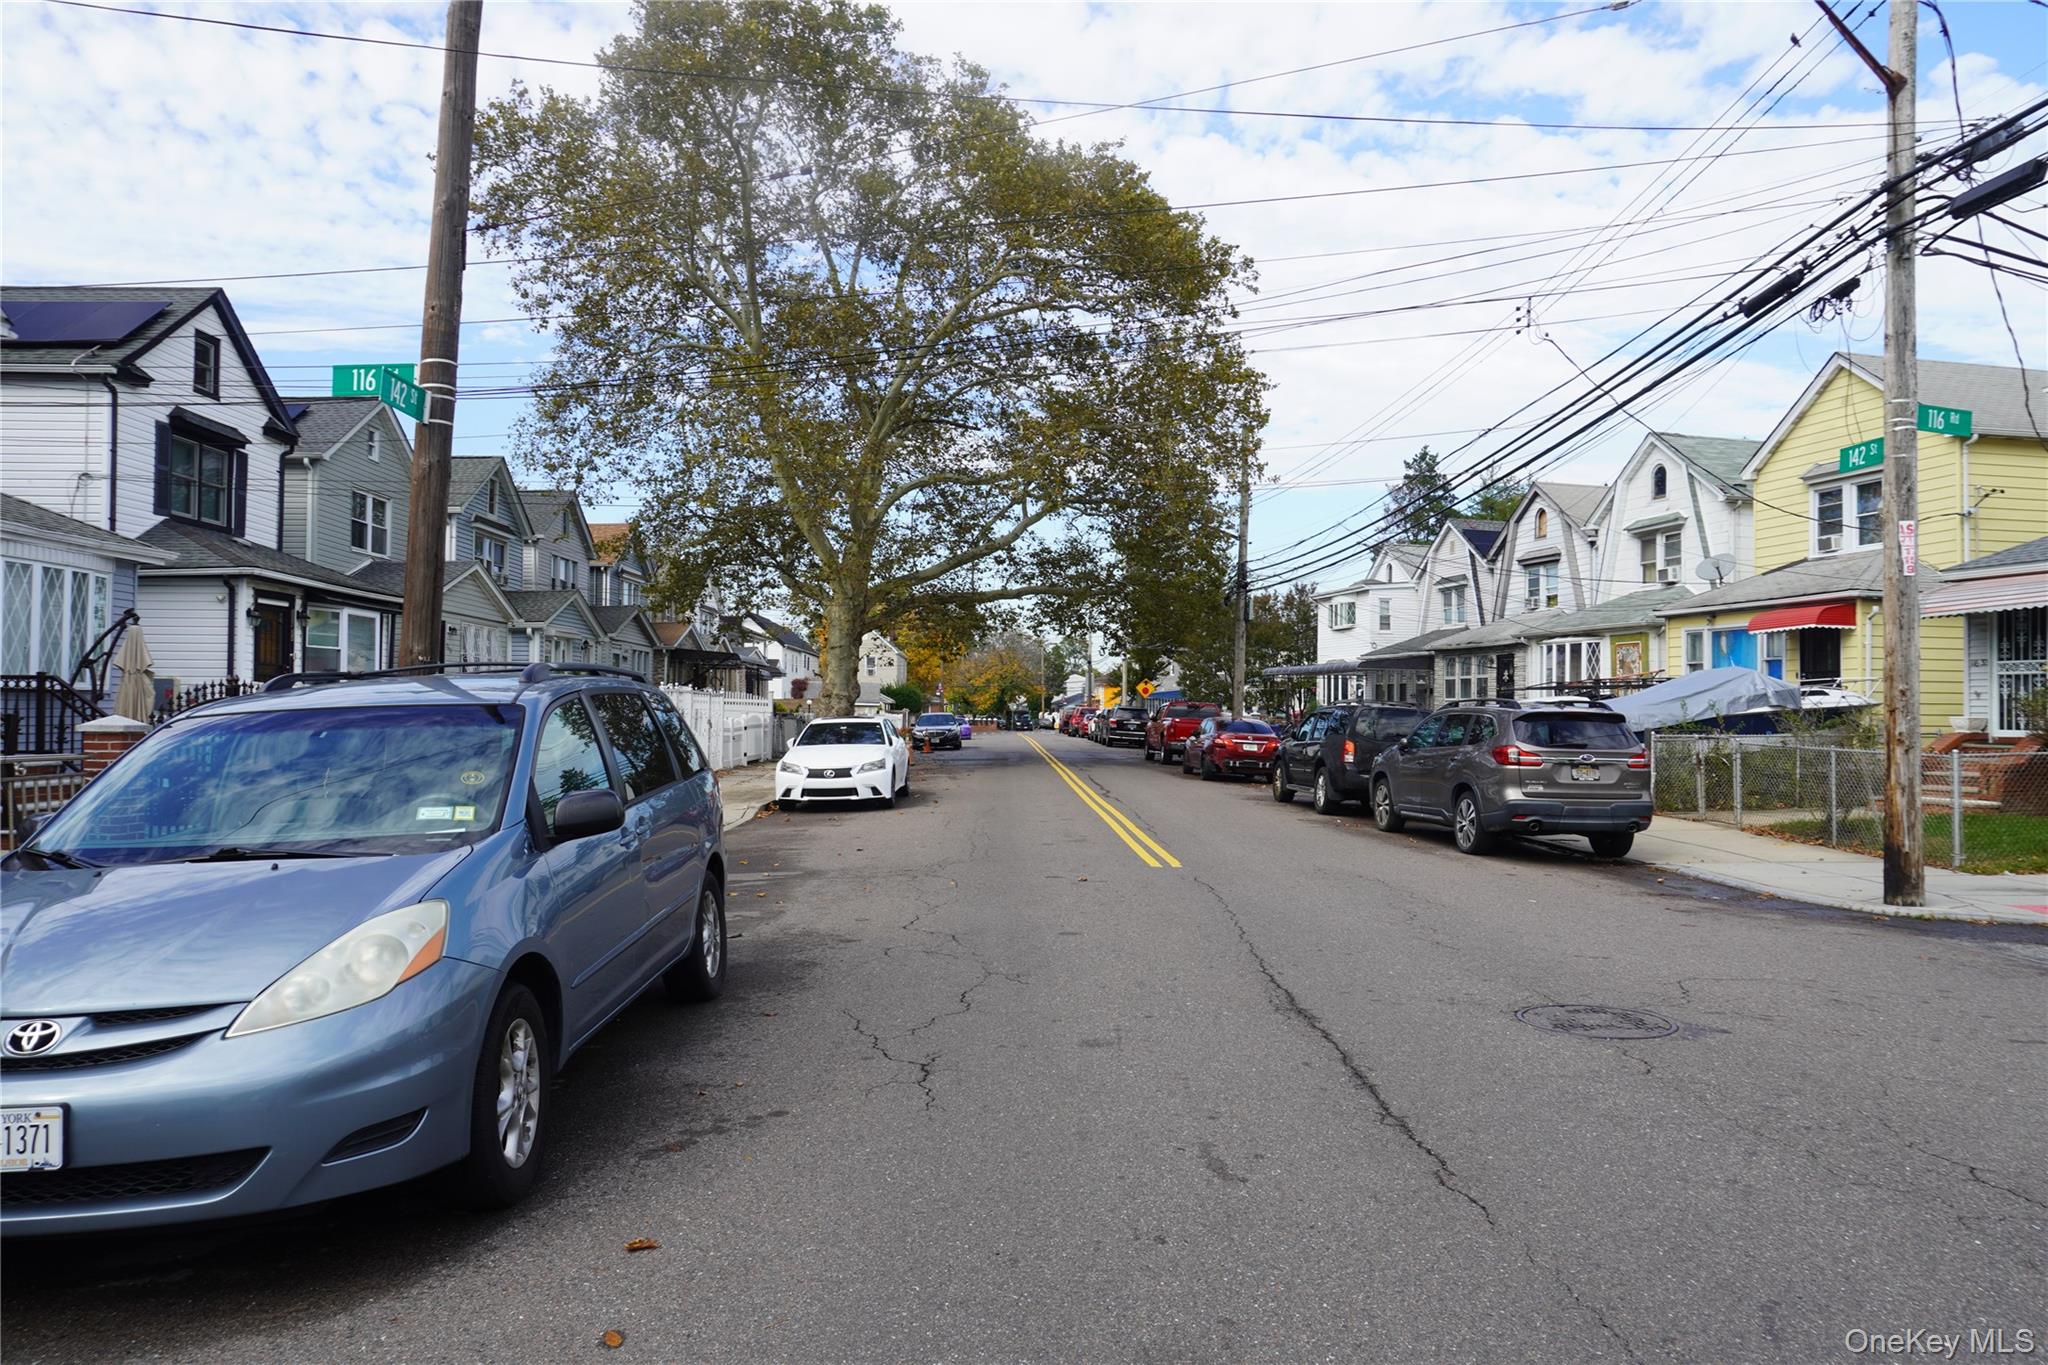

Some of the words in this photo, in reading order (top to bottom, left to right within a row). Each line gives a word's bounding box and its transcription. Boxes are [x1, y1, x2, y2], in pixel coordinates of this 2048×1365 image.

[352, 368, 376, 391] 116
[390, 377, 408, 408] 142
[1928, 409, 1945, 429] 116
[1950, 411, 1960, 425] Rd
[1849, 446, 1866, 468] 142
[1870, 443, 1878, 456] St
[1, 1112, 32, 1124] YORK
[4, 1124, 50, 1155] 1371
